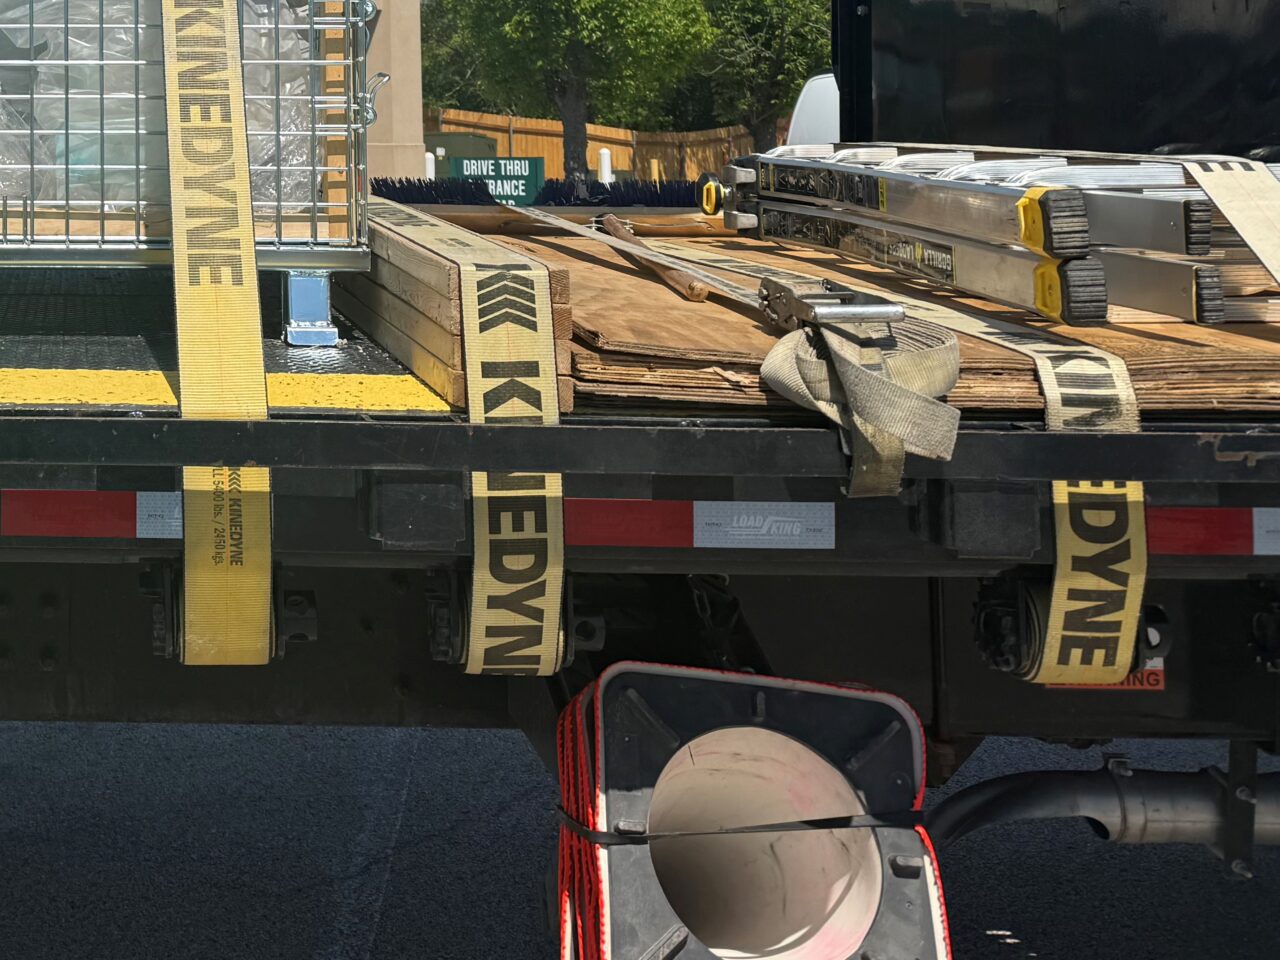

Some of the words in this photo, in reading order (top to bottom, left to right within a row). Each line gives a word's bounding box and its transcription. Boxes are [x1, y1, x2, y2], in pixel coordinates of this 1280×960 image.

[463, 160, 495, 176] DRIVE
[499, 160, 529, 176] THRU
[923, 248, 952, 271] GORILLA
[212, 480, 224, 502] 5400
[228, 498, 243, 566] KINEDYNE
[732, 515, 764, 527] LOAD
[770, 521, 802, 535] KING
